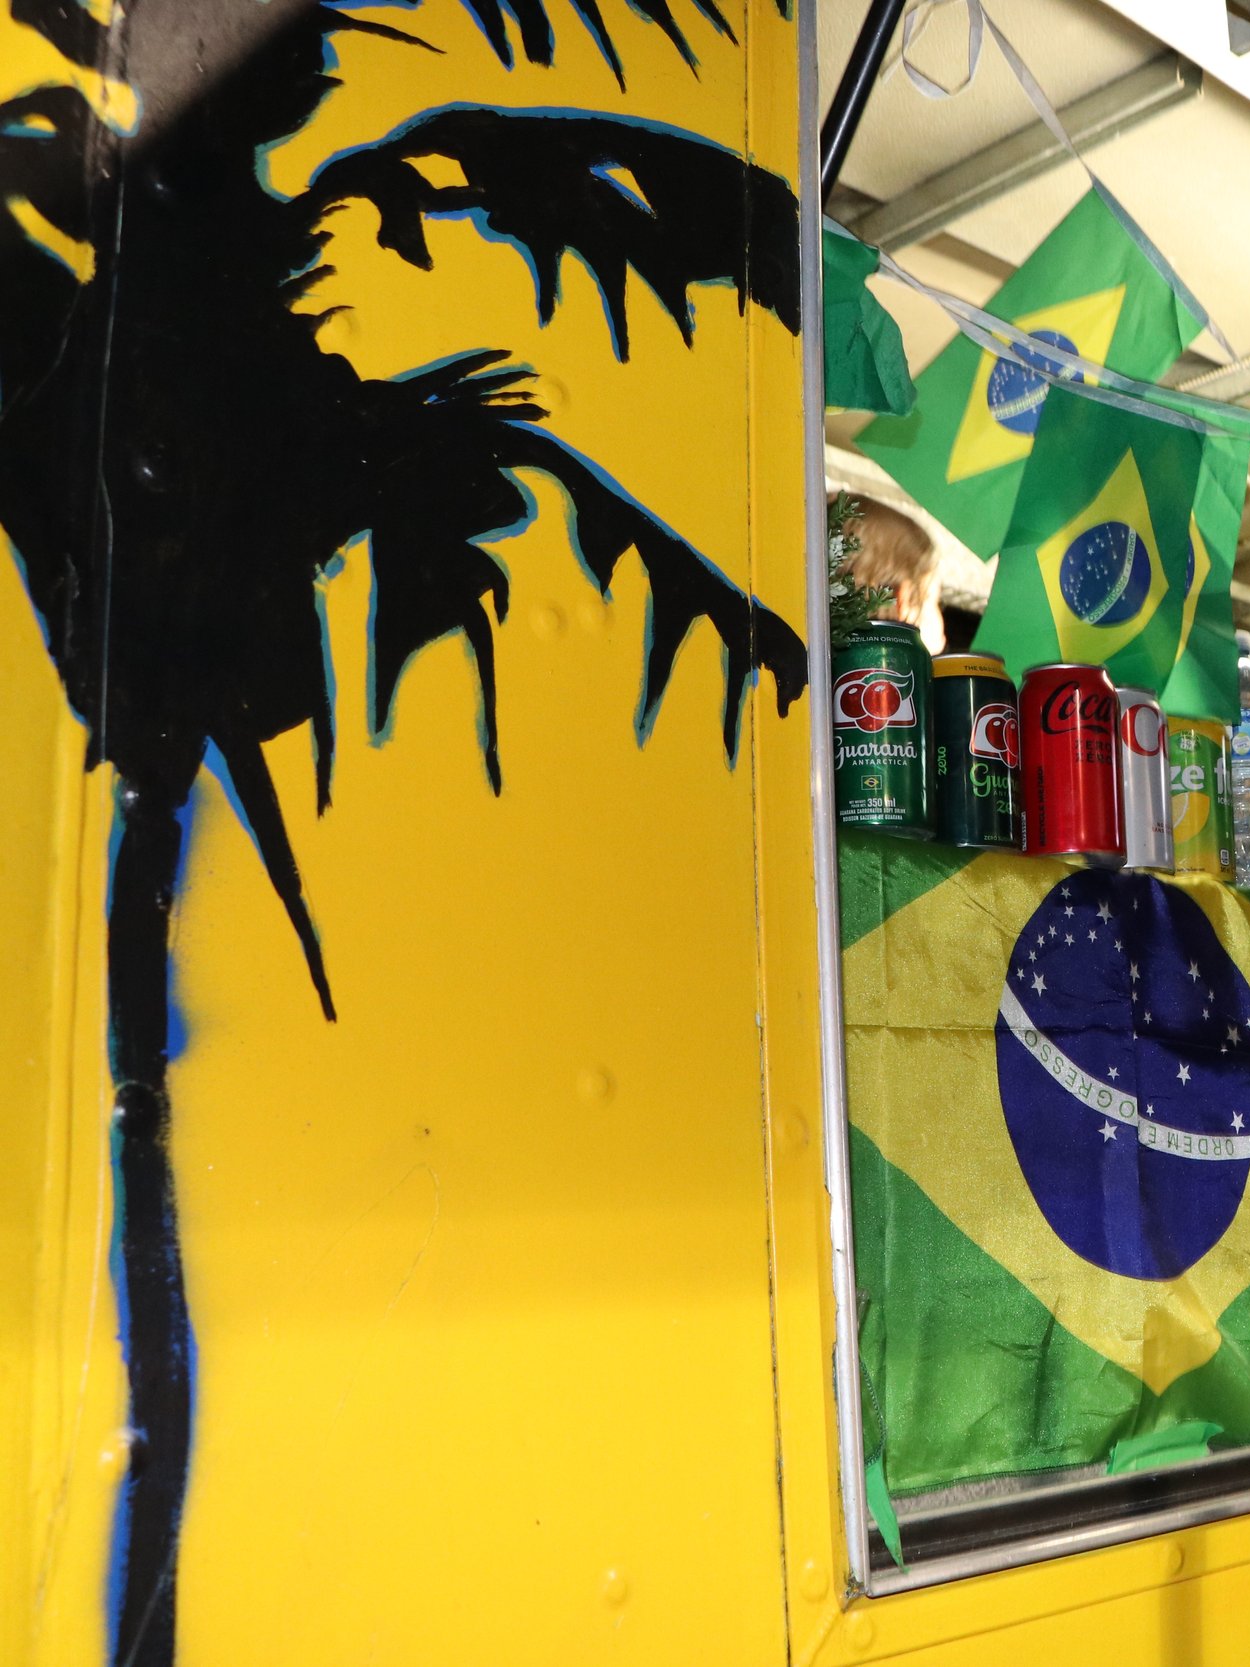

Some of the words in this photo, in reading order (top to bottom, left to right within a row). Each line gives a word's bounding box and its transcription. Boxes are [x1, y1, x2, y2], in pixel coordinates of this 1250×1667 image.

[852, 758, 908, 766] ANTARCTICA
[938, 746, 947, 775] zero
[867, 798, 883, 807] 350
[1149, 1125, 1157, 1145] E
[1168, 1131, 1235, 1156] ORDEM
